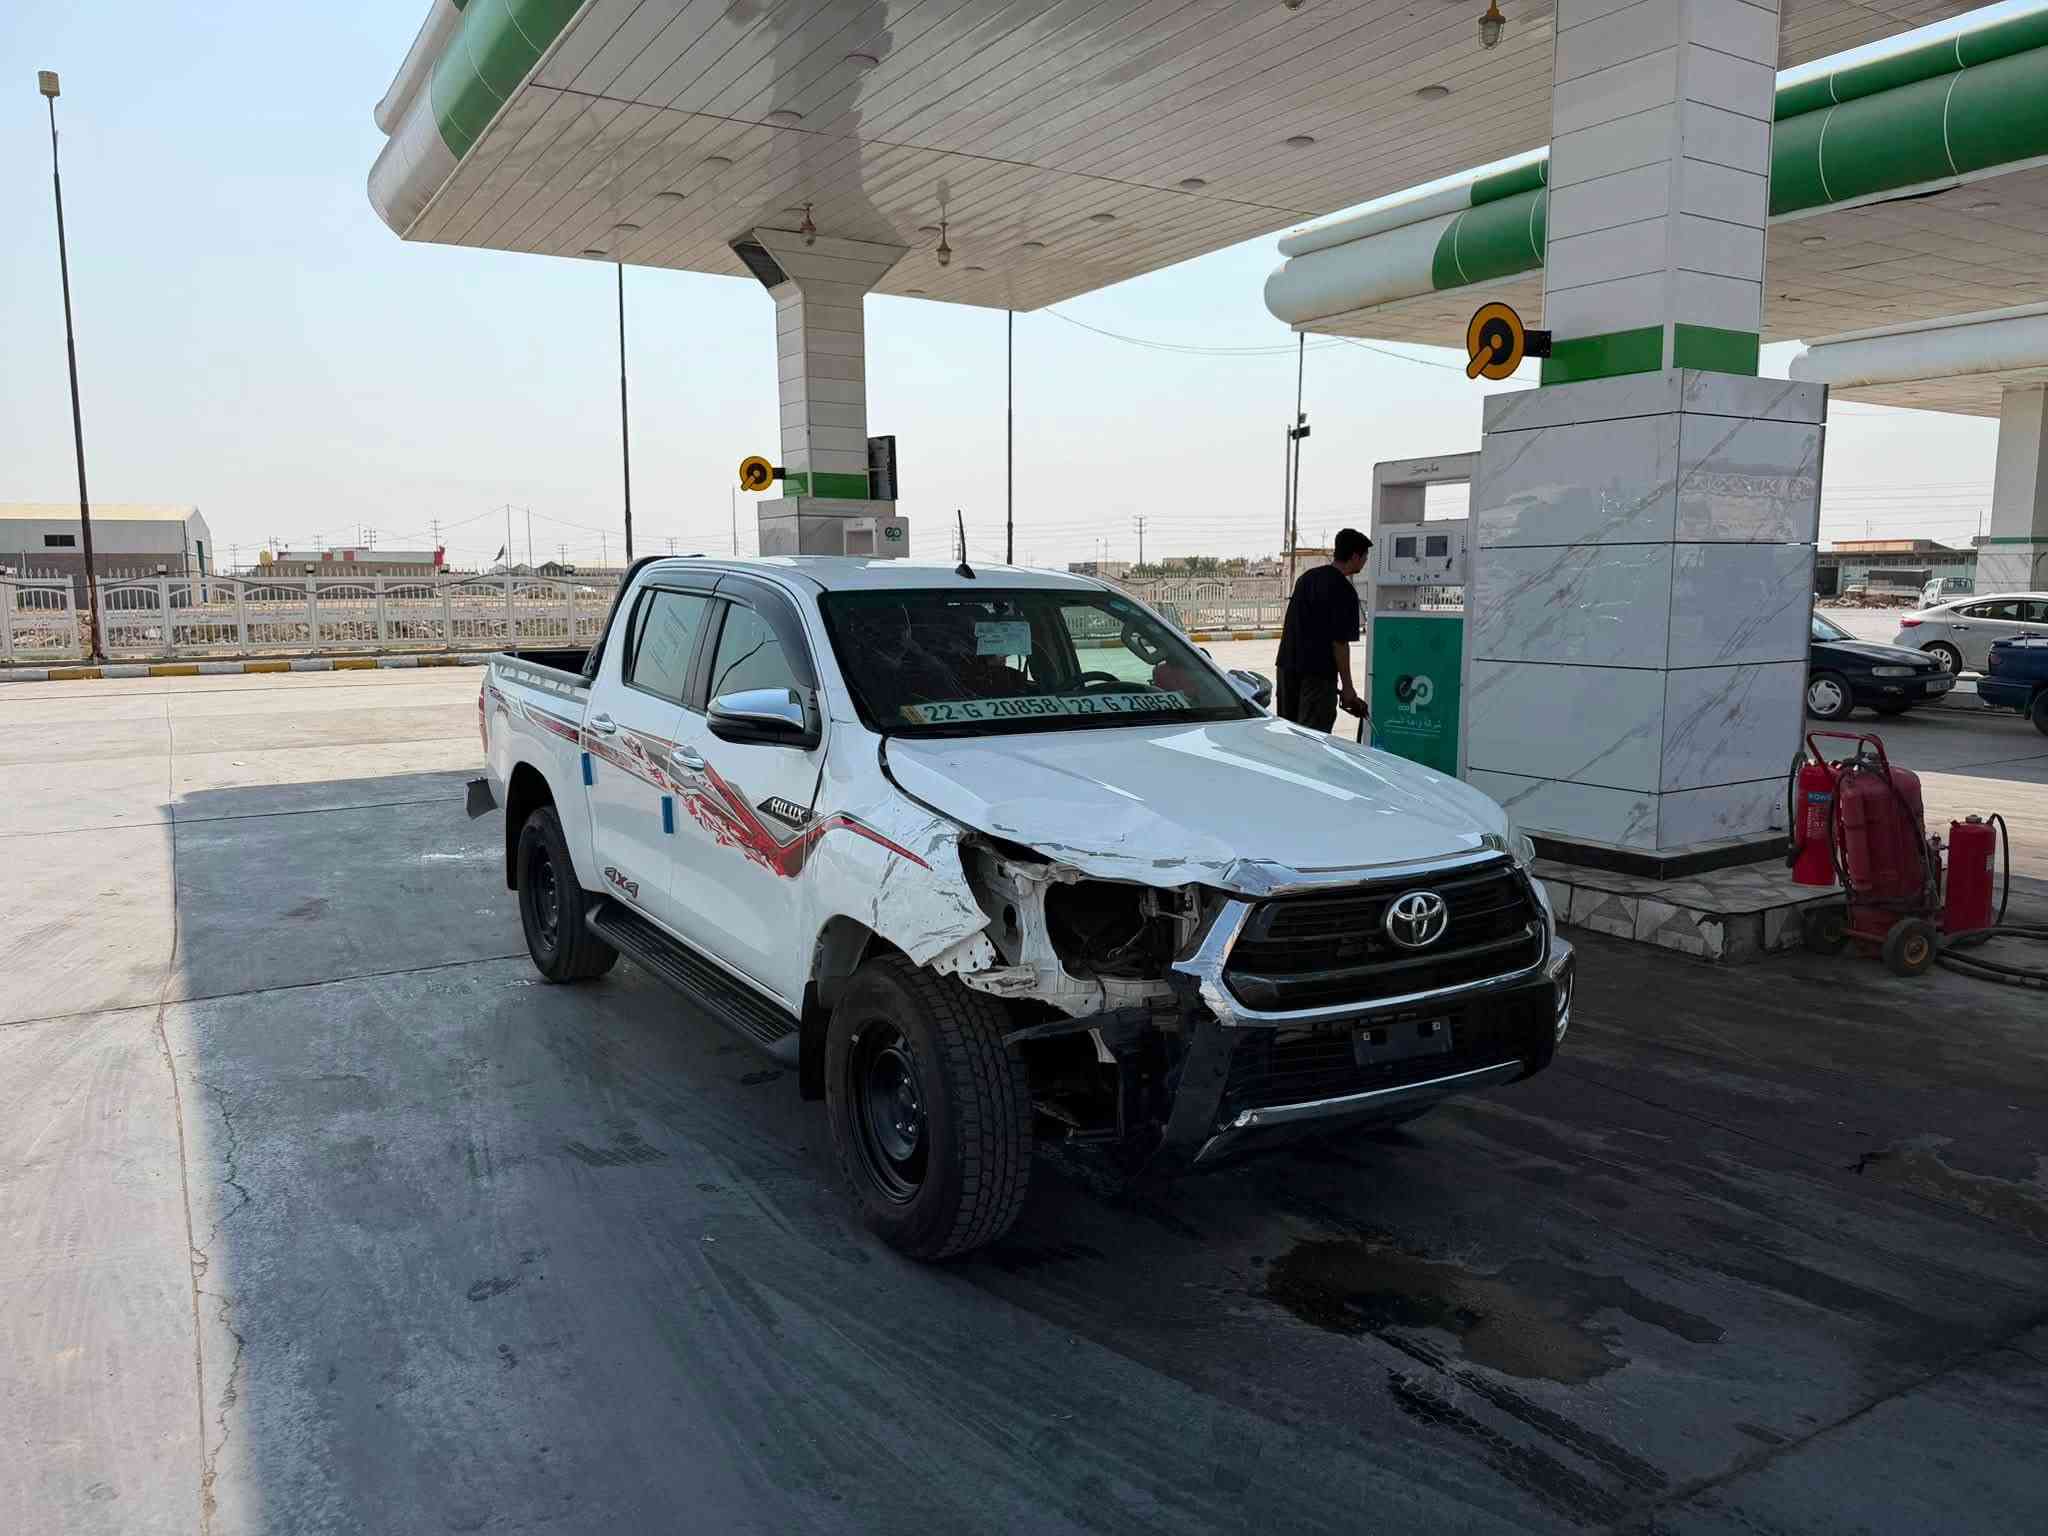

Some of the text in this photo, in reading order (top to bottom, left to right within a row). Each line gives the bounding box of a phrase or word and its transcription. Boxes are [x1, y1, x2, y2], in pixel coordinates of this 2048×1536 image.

[923, 698, 1059, 721] 22 G 20858
[1069, 693, 1187, 713] 22 G 20858
[771, 798, 805, 824] HILUX
